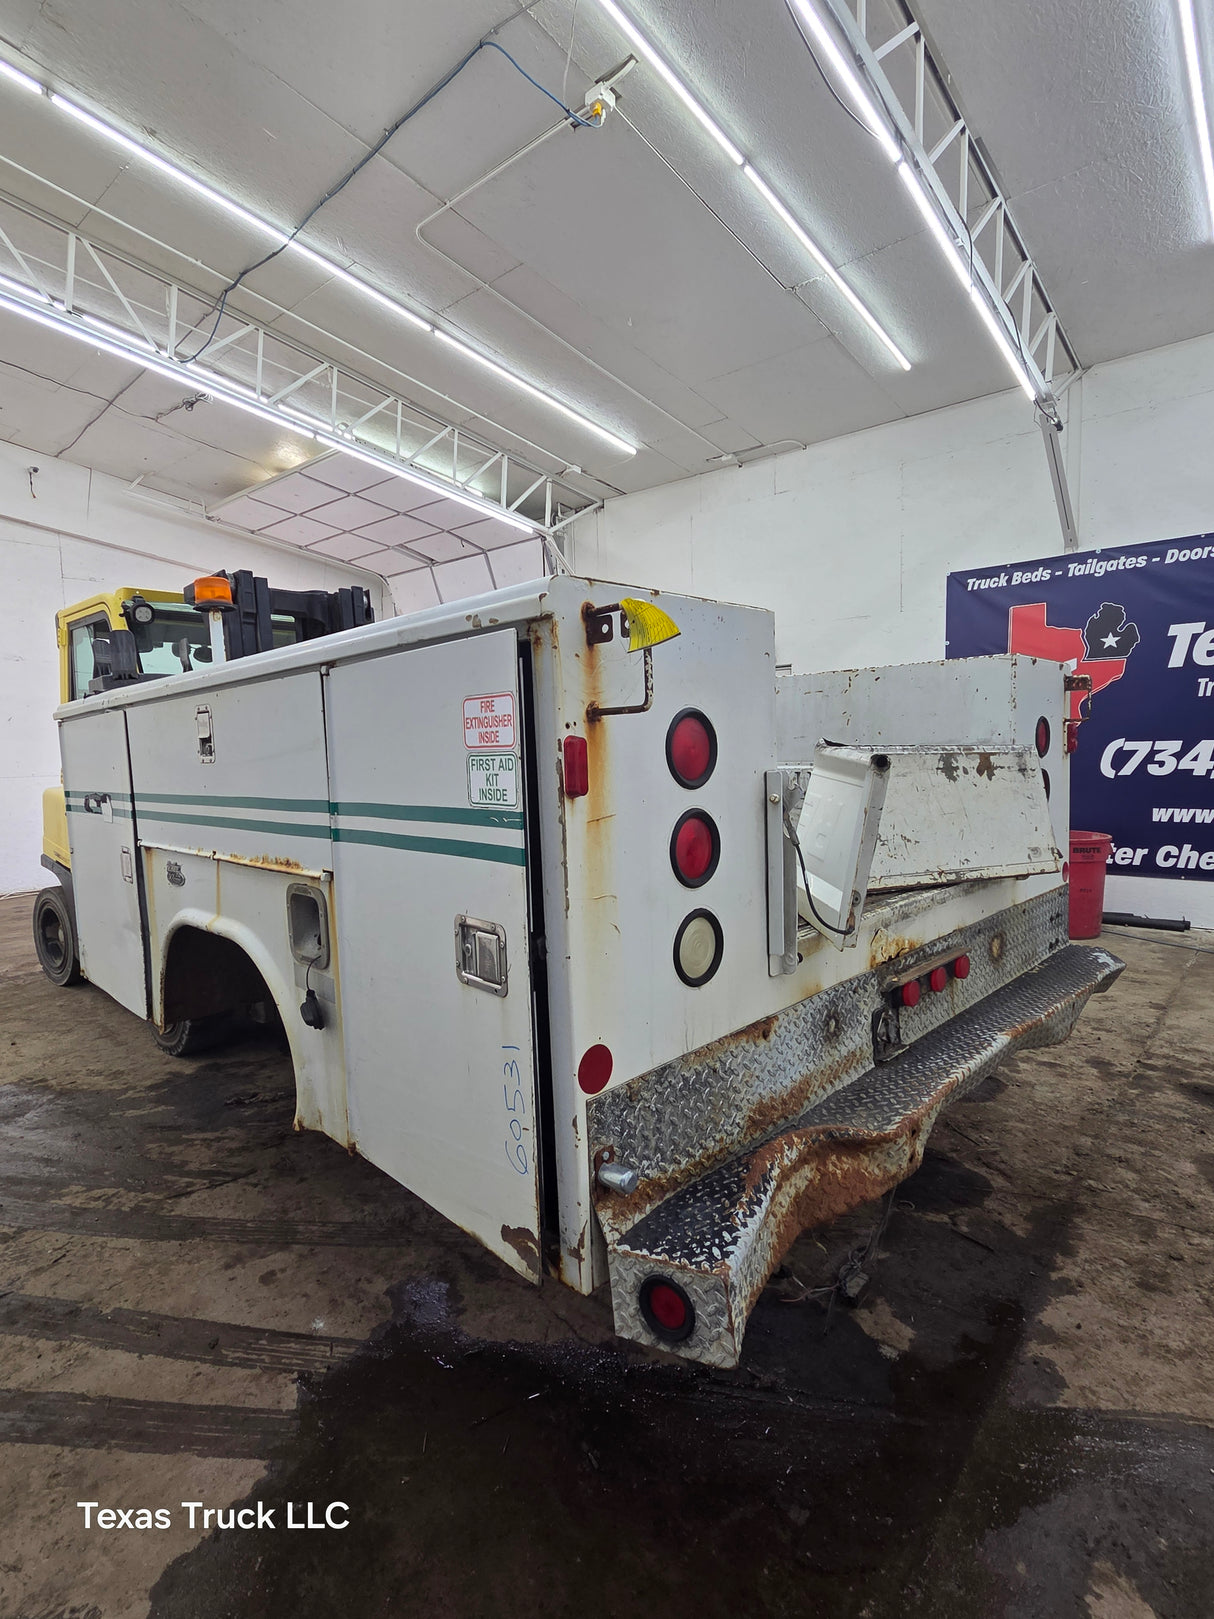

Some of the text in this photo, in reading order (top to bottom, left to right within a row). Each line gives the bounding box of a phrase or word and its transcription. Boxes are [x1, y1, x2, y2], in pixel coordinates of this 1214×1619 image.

[967, 572, 1009, 591] Truck
[1011, 567, 1052, 585] Beds
[1067, 555, 1148, 577] Tailgates
[1167, 621, 1214, 668] Te
[480, 700, 495, 713] FIRE
[466, 714, 512, 729] EXTINGUISHER
[478, 730, 500, 744] INSIDE
[471, 757, 514, 772] FIRST AID
[1100, 737, 1214, 779] (734
[485, 773, 499, 787] KIT
[478, 788, 508, 802] INSIDE
[1151, 807, 1214, 824] www
[1155, 843, 1214, 870] Che
[501, 1045, 529, 1175] 60531
